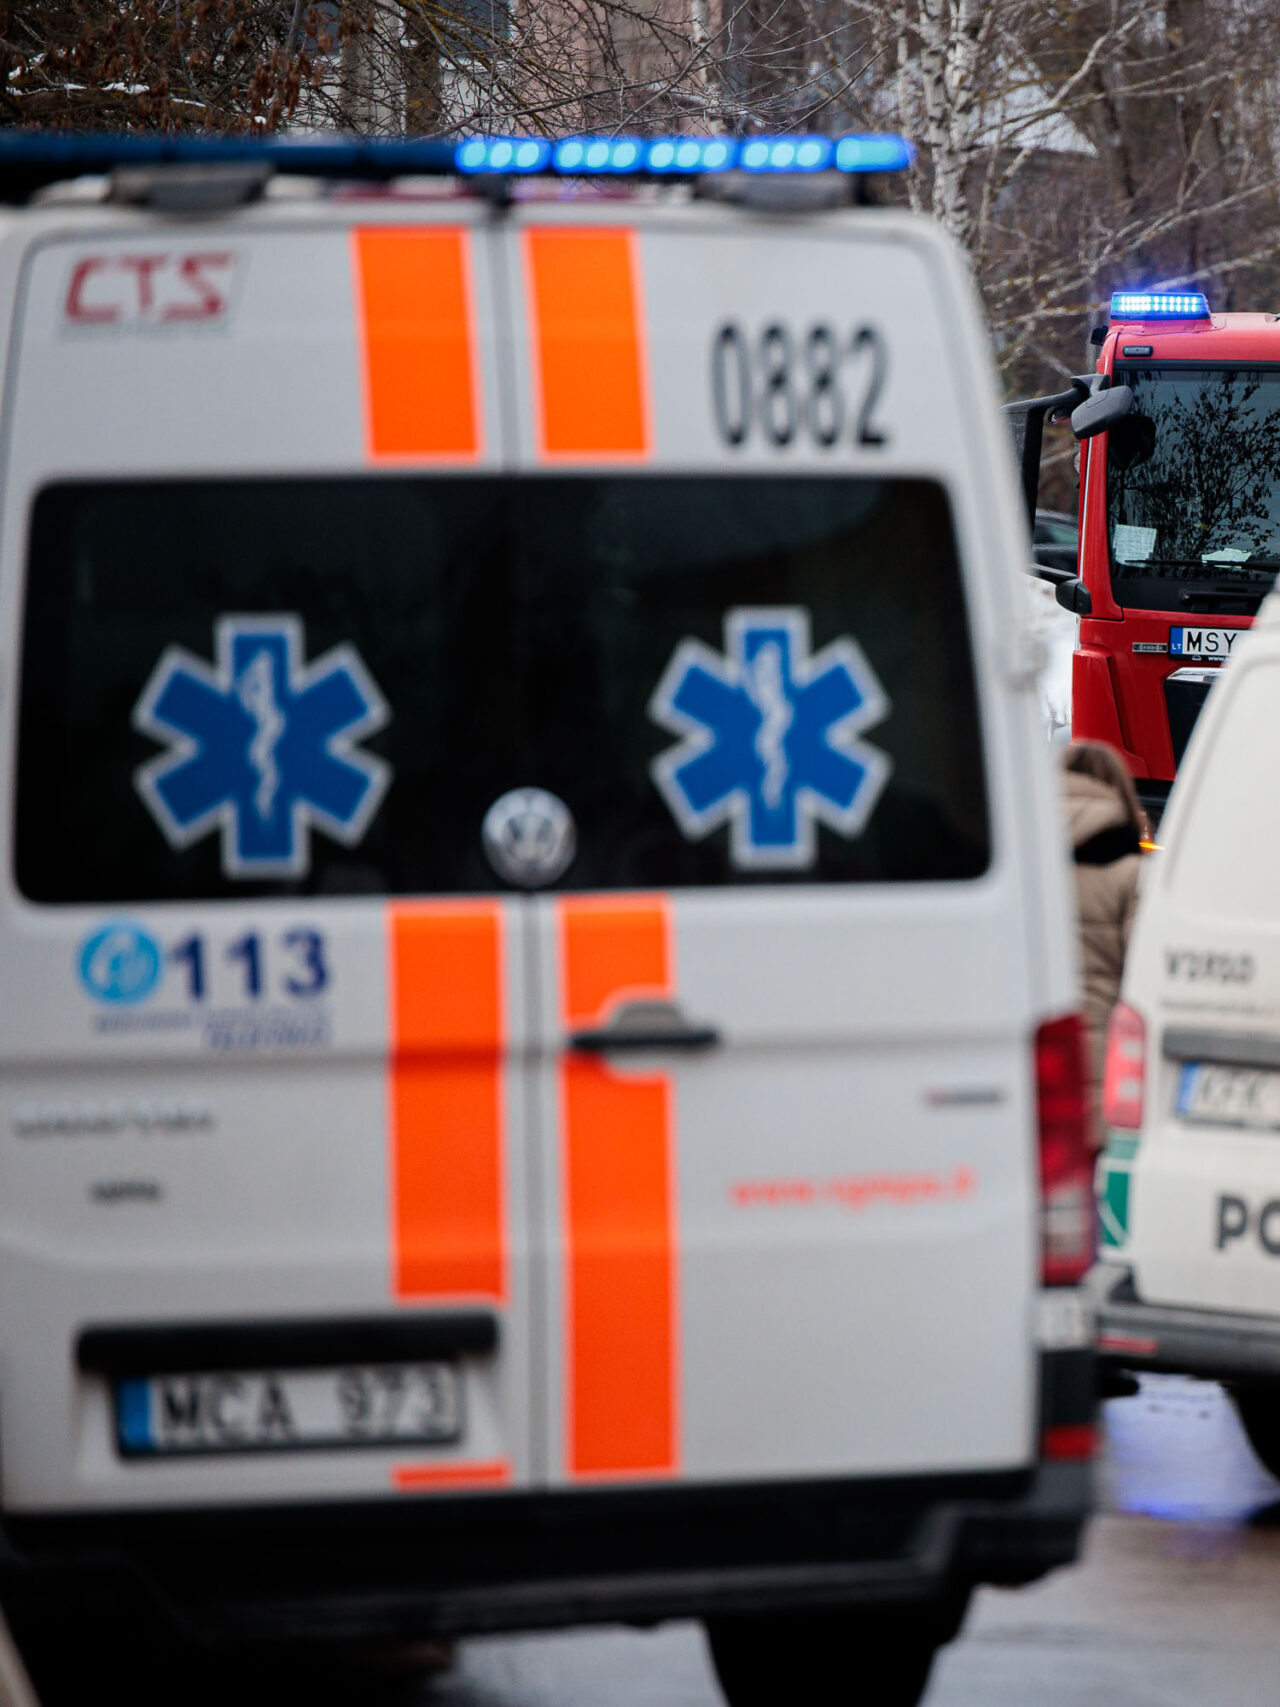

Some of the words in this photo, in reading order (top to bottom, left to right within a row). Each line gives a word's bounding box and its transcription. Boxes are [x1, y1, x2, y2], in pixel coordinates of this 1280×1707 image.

[66, 253, 234, 324] CTS
[711, 321, 890, 451] 0882
[1172, 643, 1182, 651] LT
[1187, 631, 1237, 654] MSY
[169, 925, 331, 1001] 113
[158, 1371, 297, 1445] MCA
